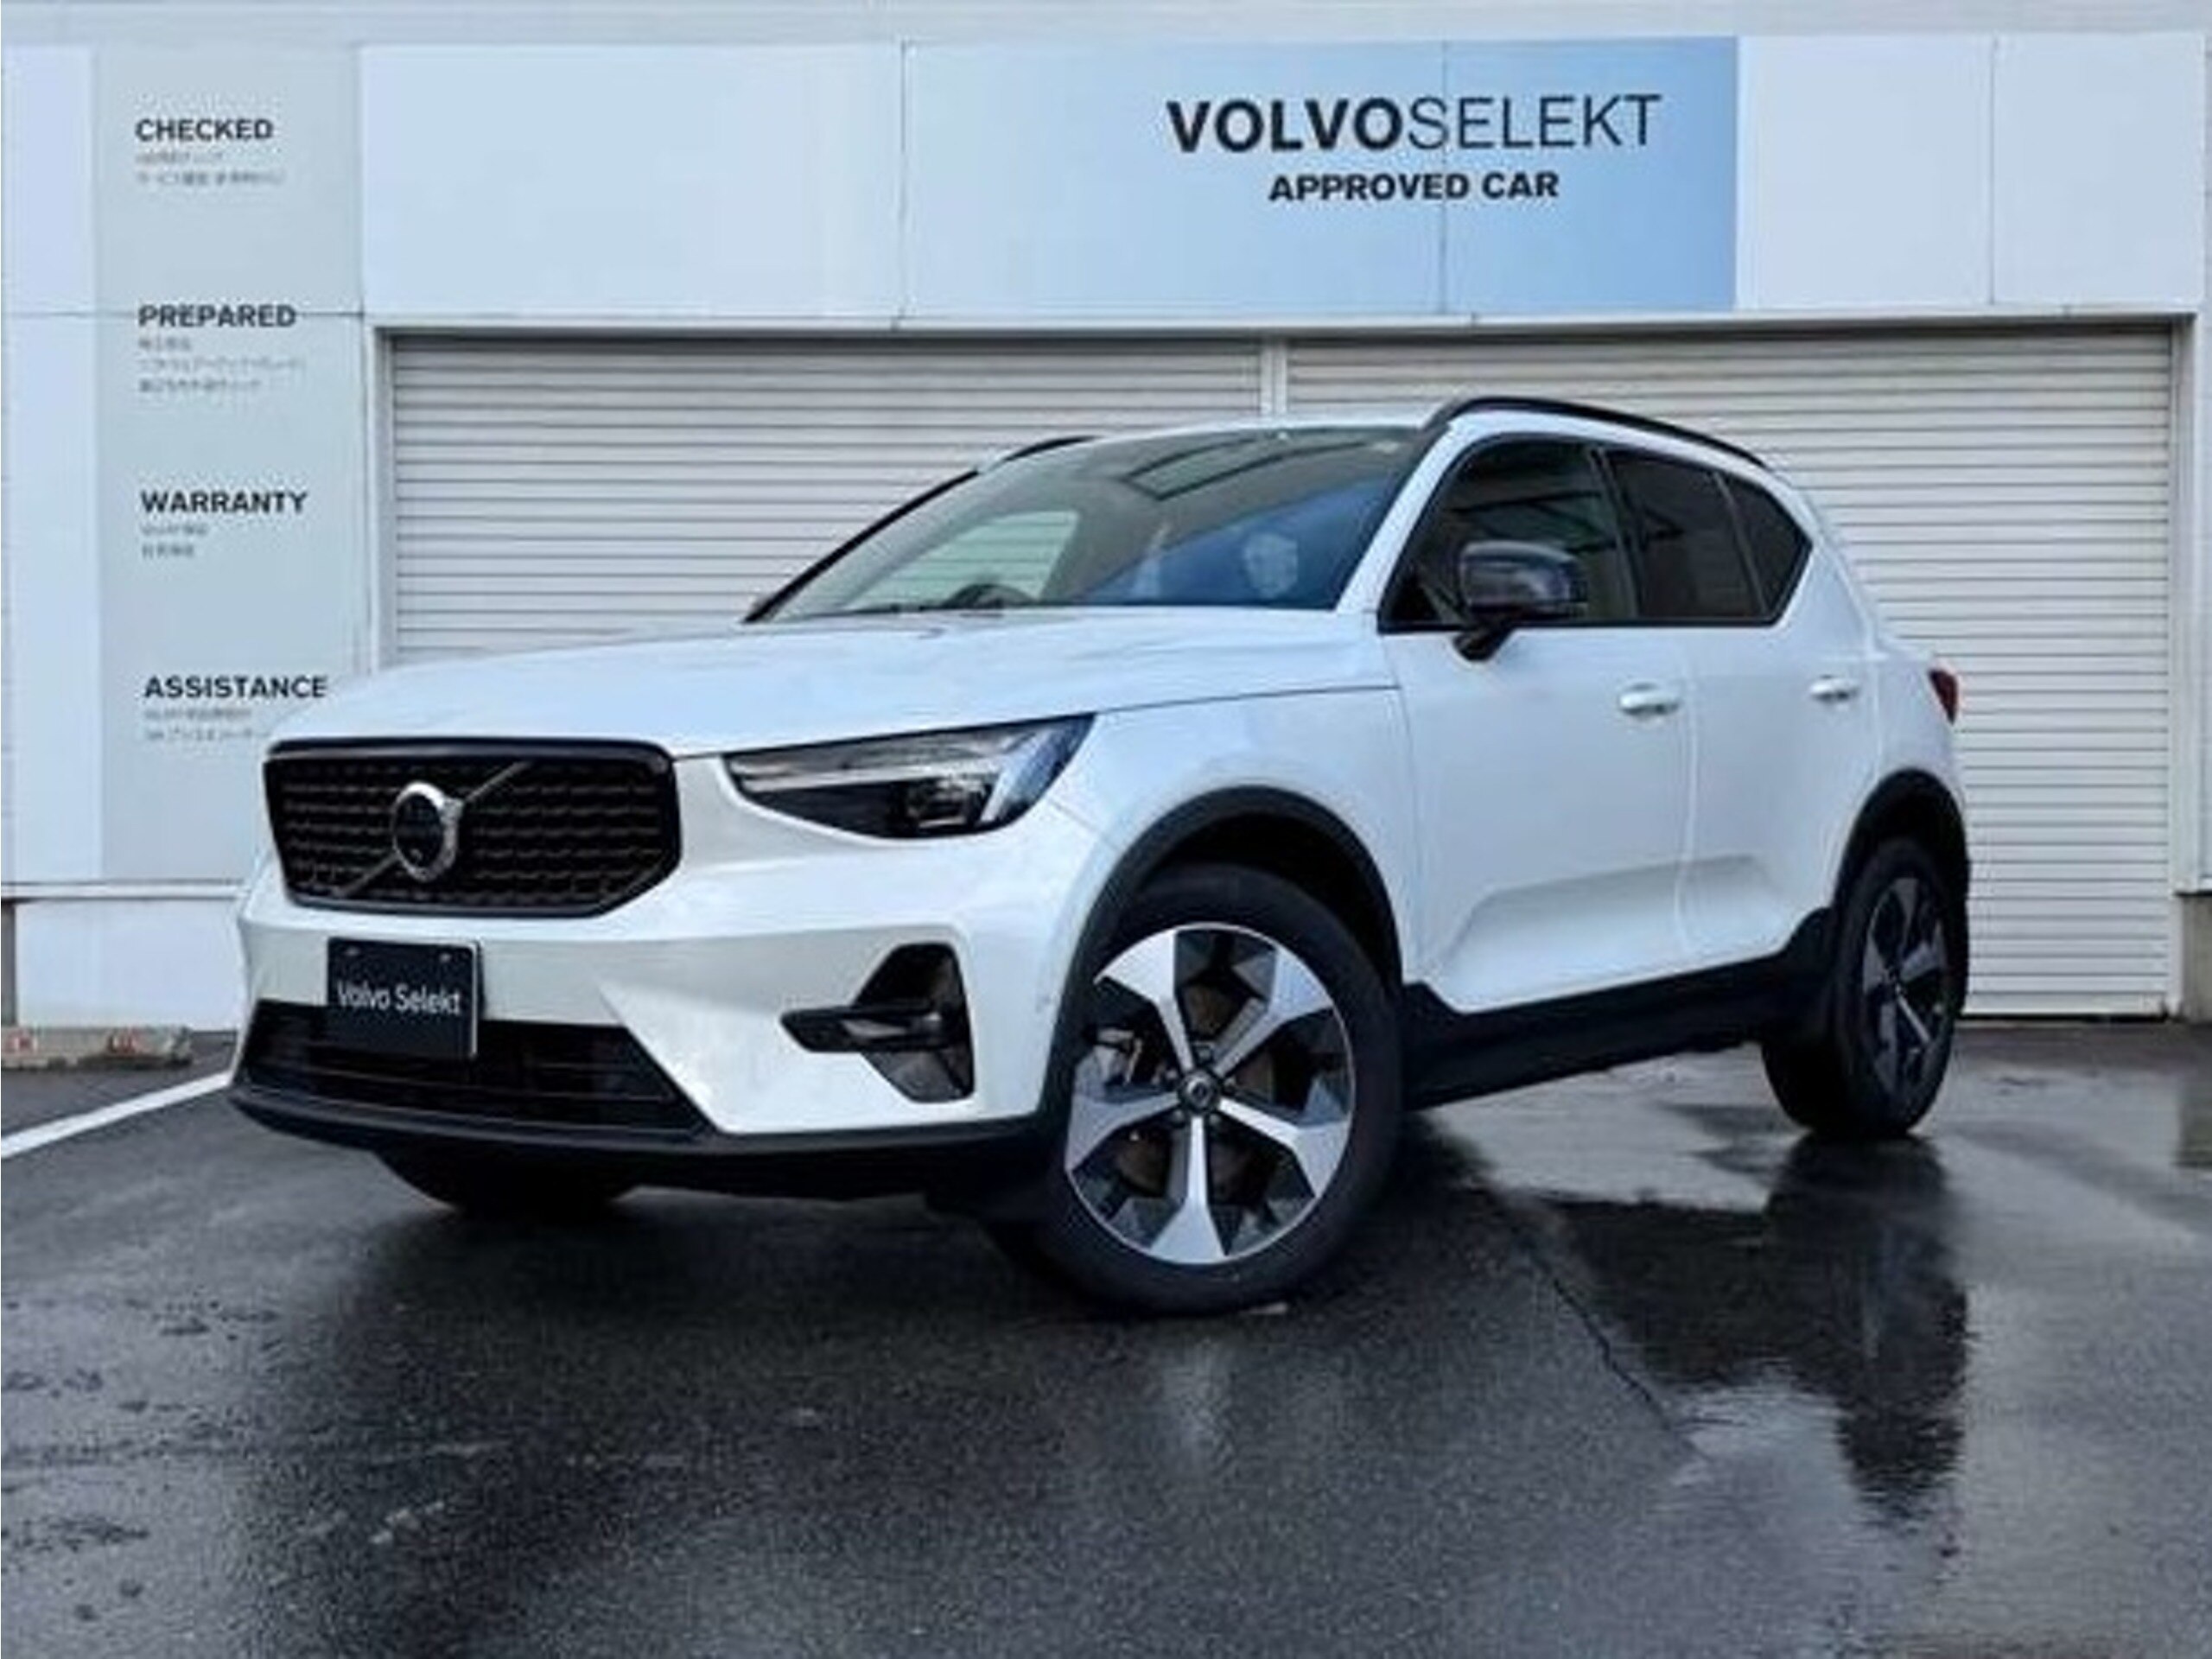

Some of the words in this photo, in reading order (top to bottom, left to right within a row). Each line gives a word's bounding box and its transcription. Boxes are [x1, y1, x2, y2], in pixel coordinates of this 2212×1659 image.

[135, 118, 274, 142] CHECKED
[1268, 172, 1470, 201] APPROVED
[1482, 171, 1560, 200] CAR
[138, 304, 297, 327] PREPARED
[141, 491, 308, 512] WARRANTY
[144, 675, 329, 698] ASSISTANCE
[337, 979, 391, 1011] Volvo
[395, 982, 461, 1015] Selekt
